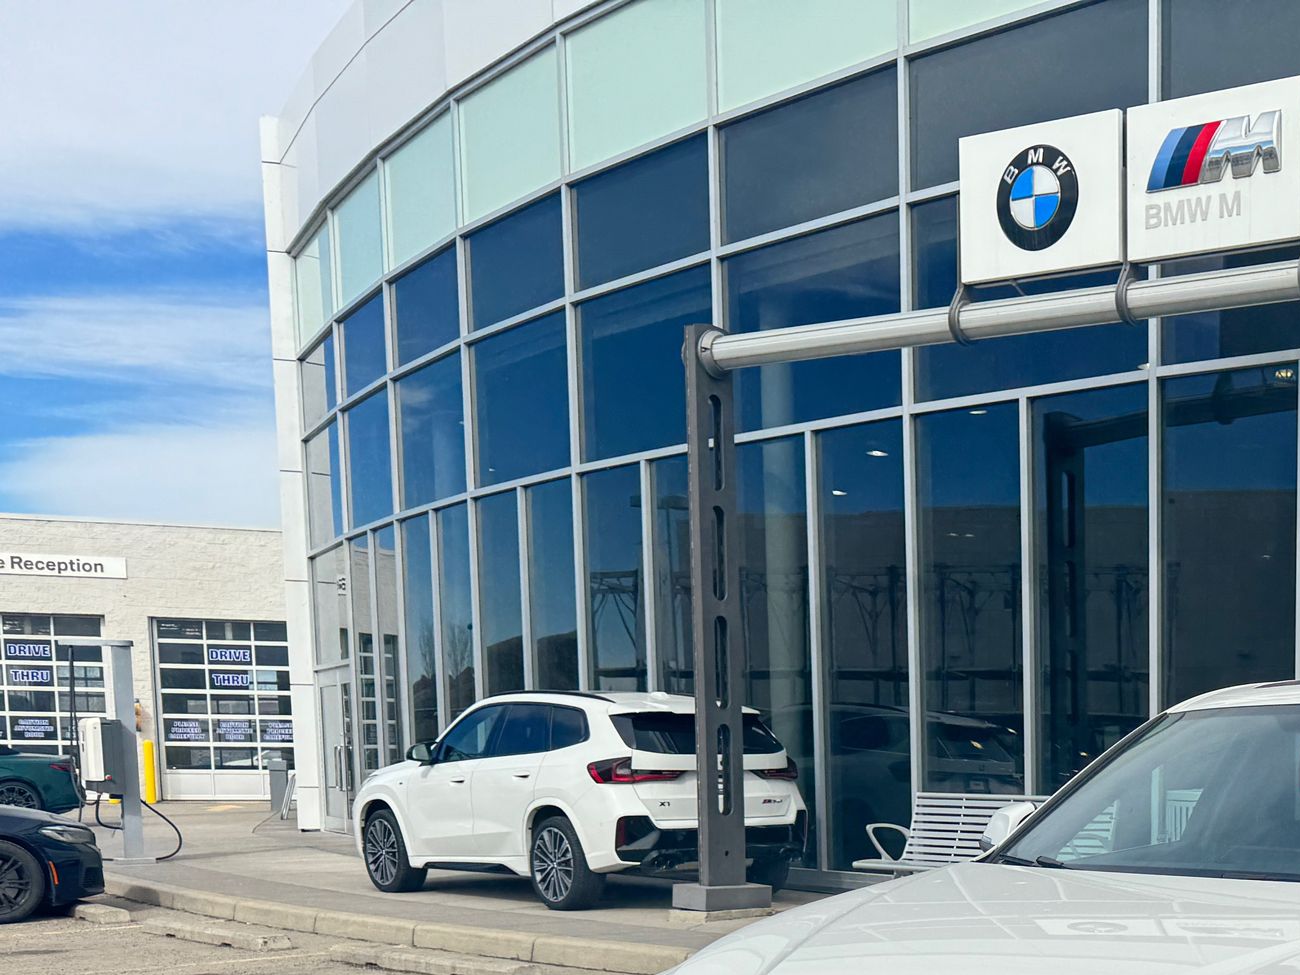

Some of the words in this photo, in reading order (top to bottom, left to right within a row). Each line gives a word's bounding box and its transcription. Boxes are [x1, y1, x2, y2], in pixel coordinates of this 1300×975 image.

[1003, 147, 1072, 185] BMW
[1144, 195, 1212, 230] BMW
[1218, 190, 1241, 219] M
[10, 555, 104, 574] Reception
[7, 644, 50, 657] DRIVE
[209, 649, 250, 661] DRIVE
[11, 669, 51, 683] THRU
[212, 673, 249, 686] THRU
